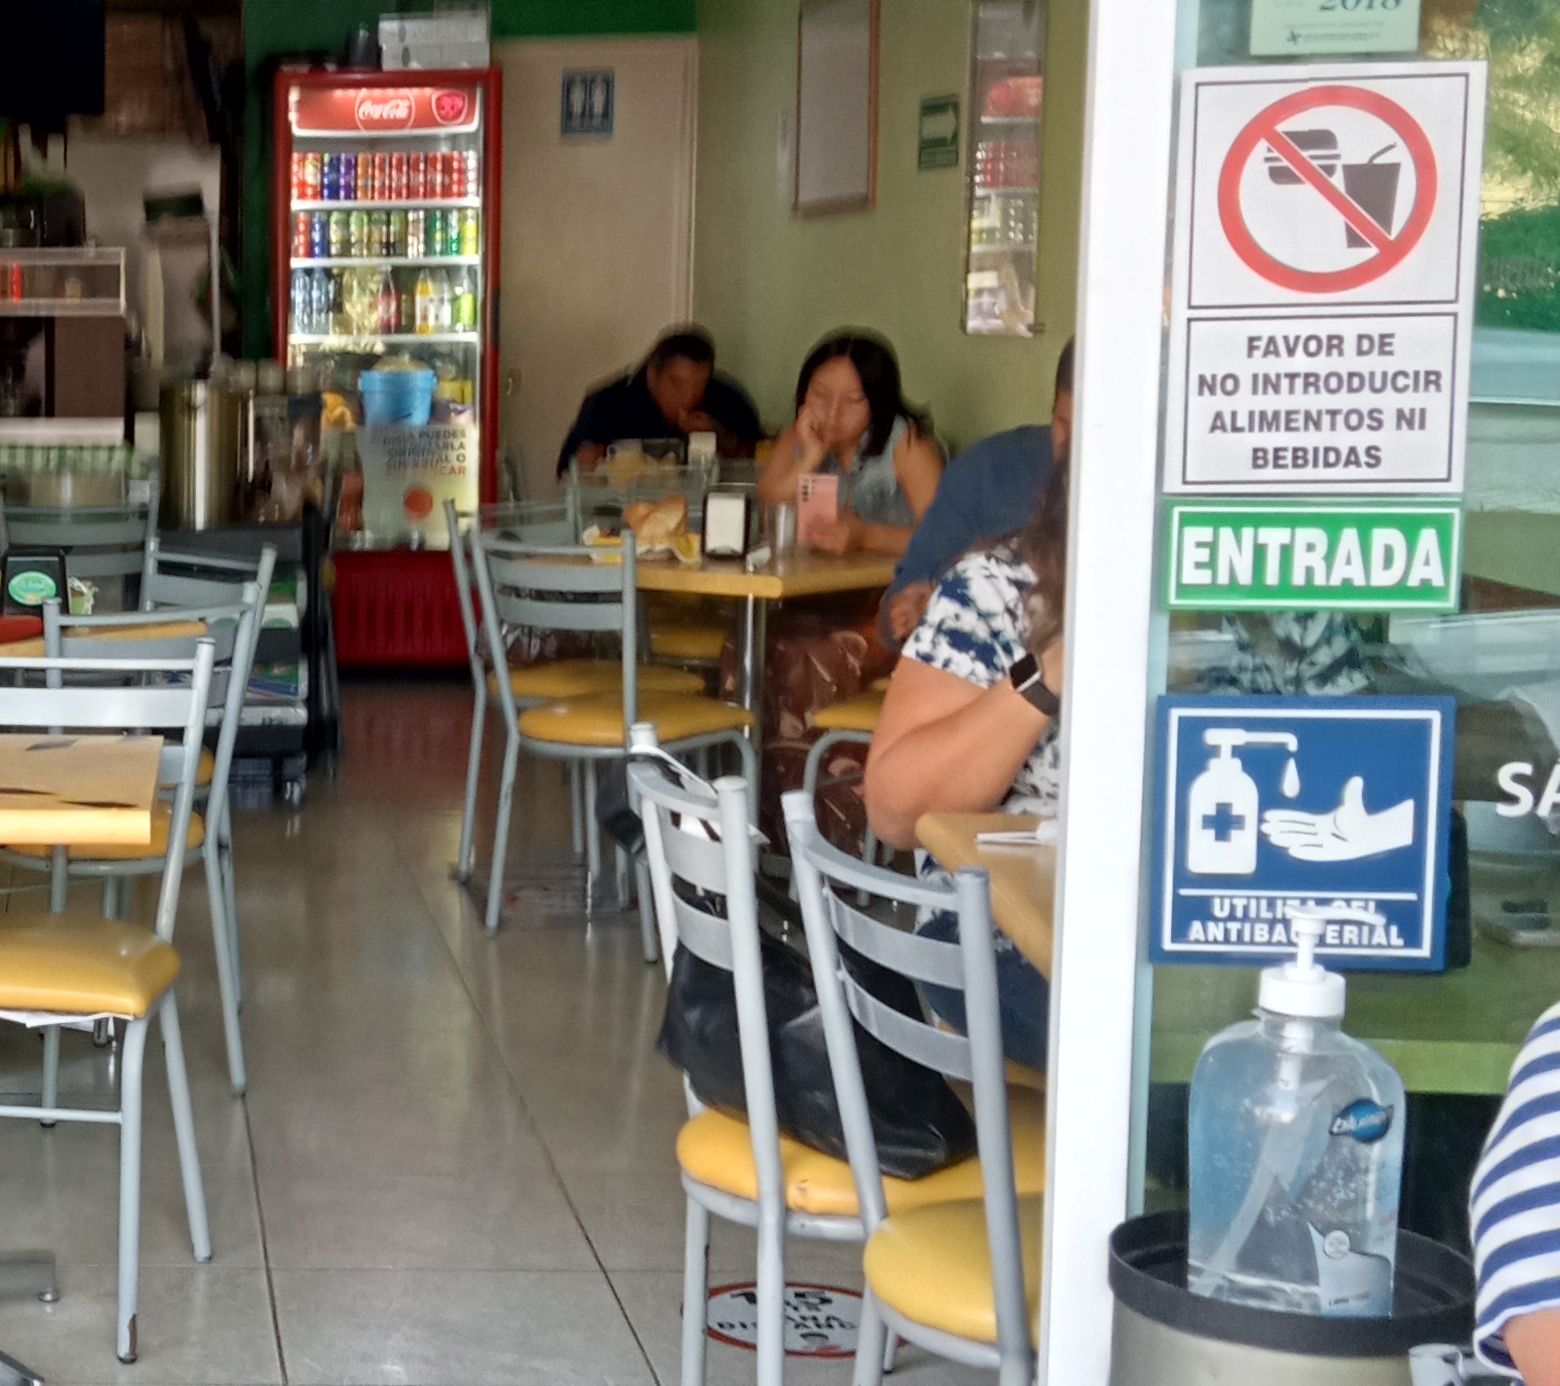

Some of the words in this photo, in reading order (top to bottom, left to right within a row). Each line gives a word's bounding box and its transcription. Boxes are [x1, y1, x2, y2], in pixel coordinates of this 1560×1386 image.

[1246, 334, 1345, 359] FAVOR
[1355, 332, 1396, 357] DE
[1197, 373, 1241, 397] NO
[1251, 370, 1443, 396] INTRODUCIR
[1208, 408, 1385, 434] ALIMENTOS
[1395, 407, 1427, 431] NI
[1251, 445, 1383, 470] BEBIDAS
[1180, 526, 1445, 588] ENTRADA
